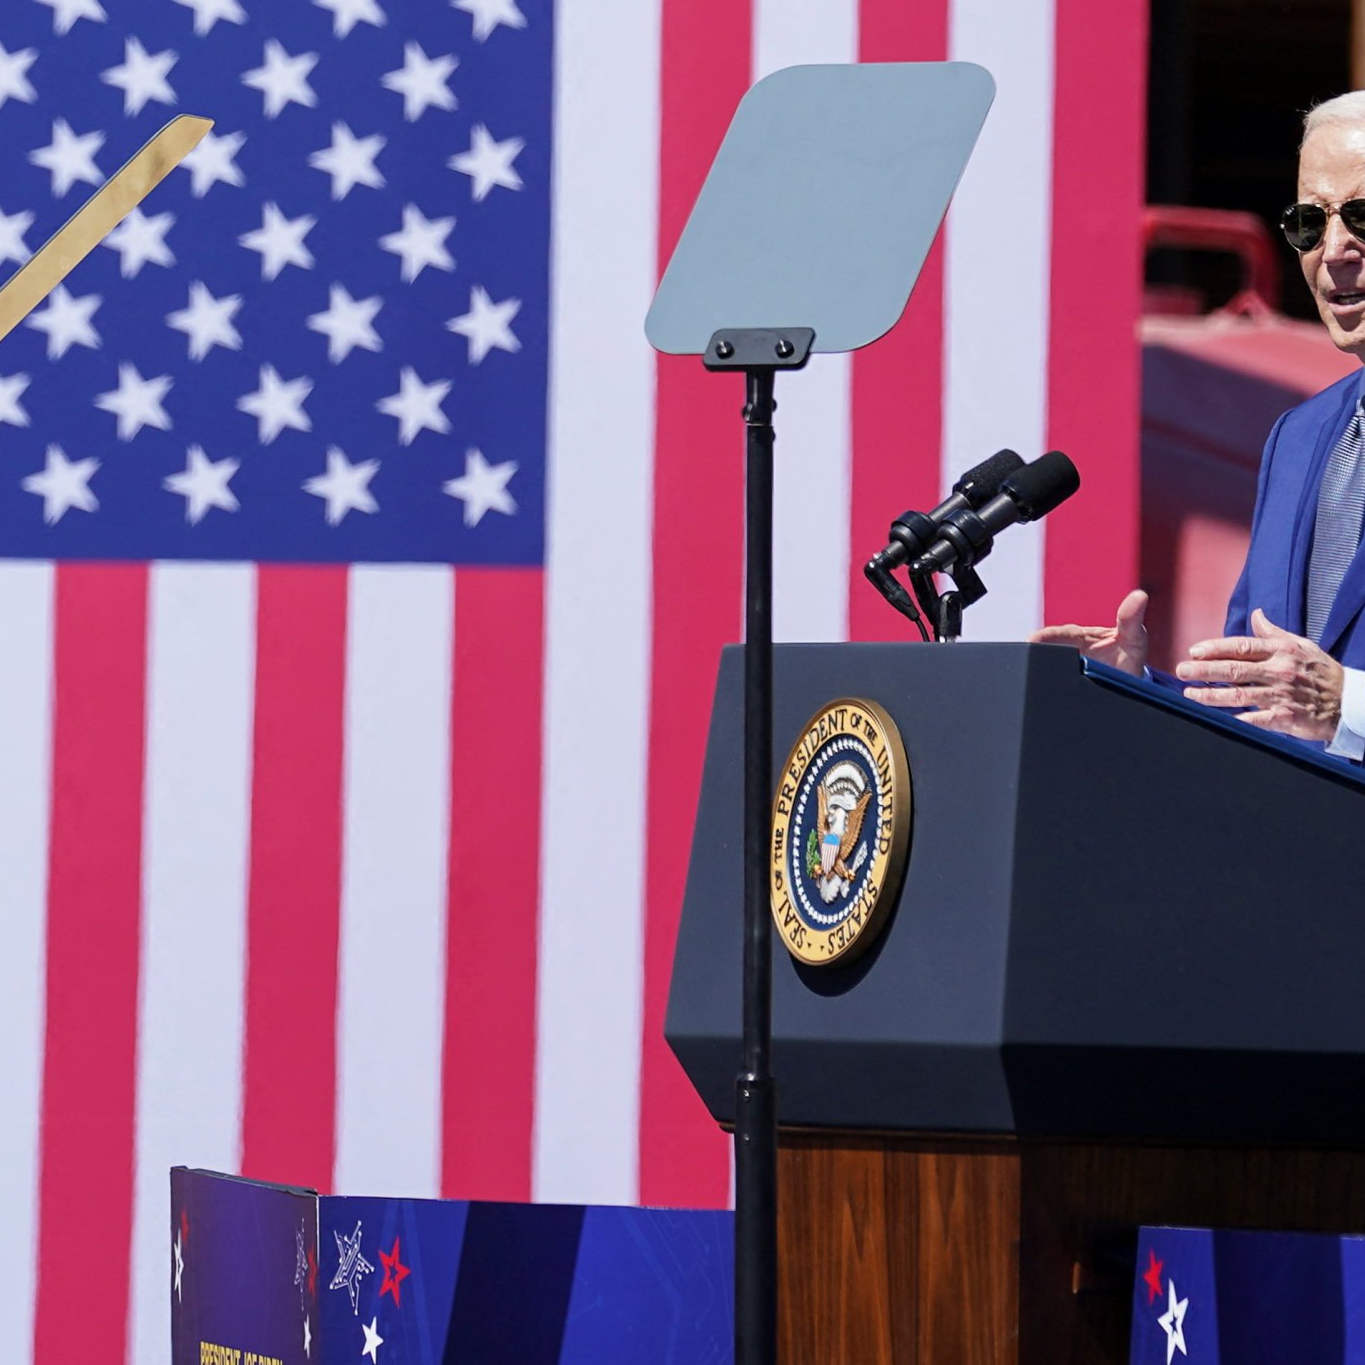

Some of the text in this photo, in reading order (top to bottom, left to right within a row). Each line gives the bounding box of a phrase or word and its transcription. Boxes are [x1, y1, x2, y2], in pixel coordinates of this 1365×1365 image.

[851, 713, 863, 730] OF
[864, 719, 877, 747] THE
[778, 709, 848, 816] PRESIDENT
[877, 746, 893, 854] UNITED
[774, 828, 784, 864] THE
[779, 892, 807, 949] SEAL
[828, 879, 878, 955] STATES
